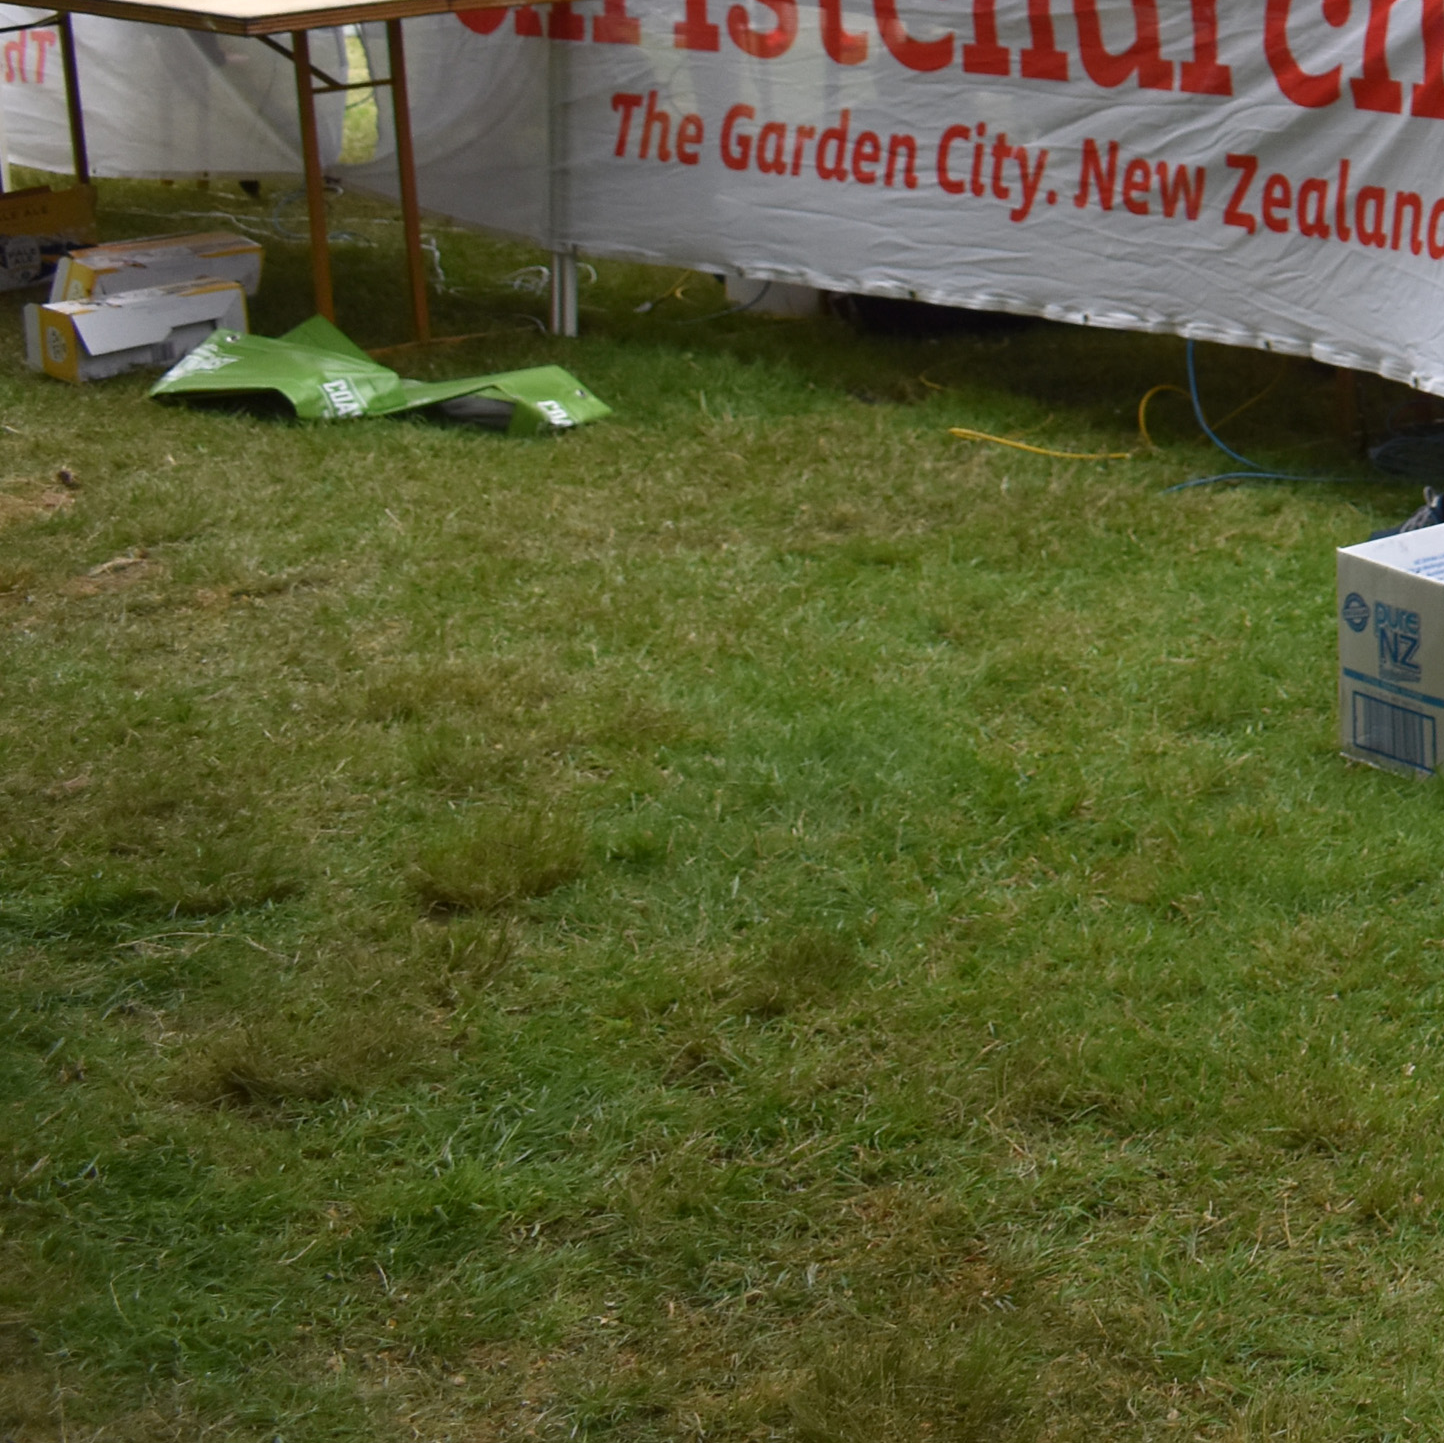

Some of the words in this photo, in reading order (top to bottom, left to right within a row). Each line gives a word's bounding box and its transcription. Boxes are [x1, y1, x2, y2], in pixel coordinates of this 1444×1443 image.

[613, 93, 703, 166] The
[720, 104, 918, 190] Garden
[936, 125, 1058, 223] City.
[1074, 139, 1204, 221] New
[1374, 600, 1420, 638] pure
[1379, 628, 1420, 670] NZ
